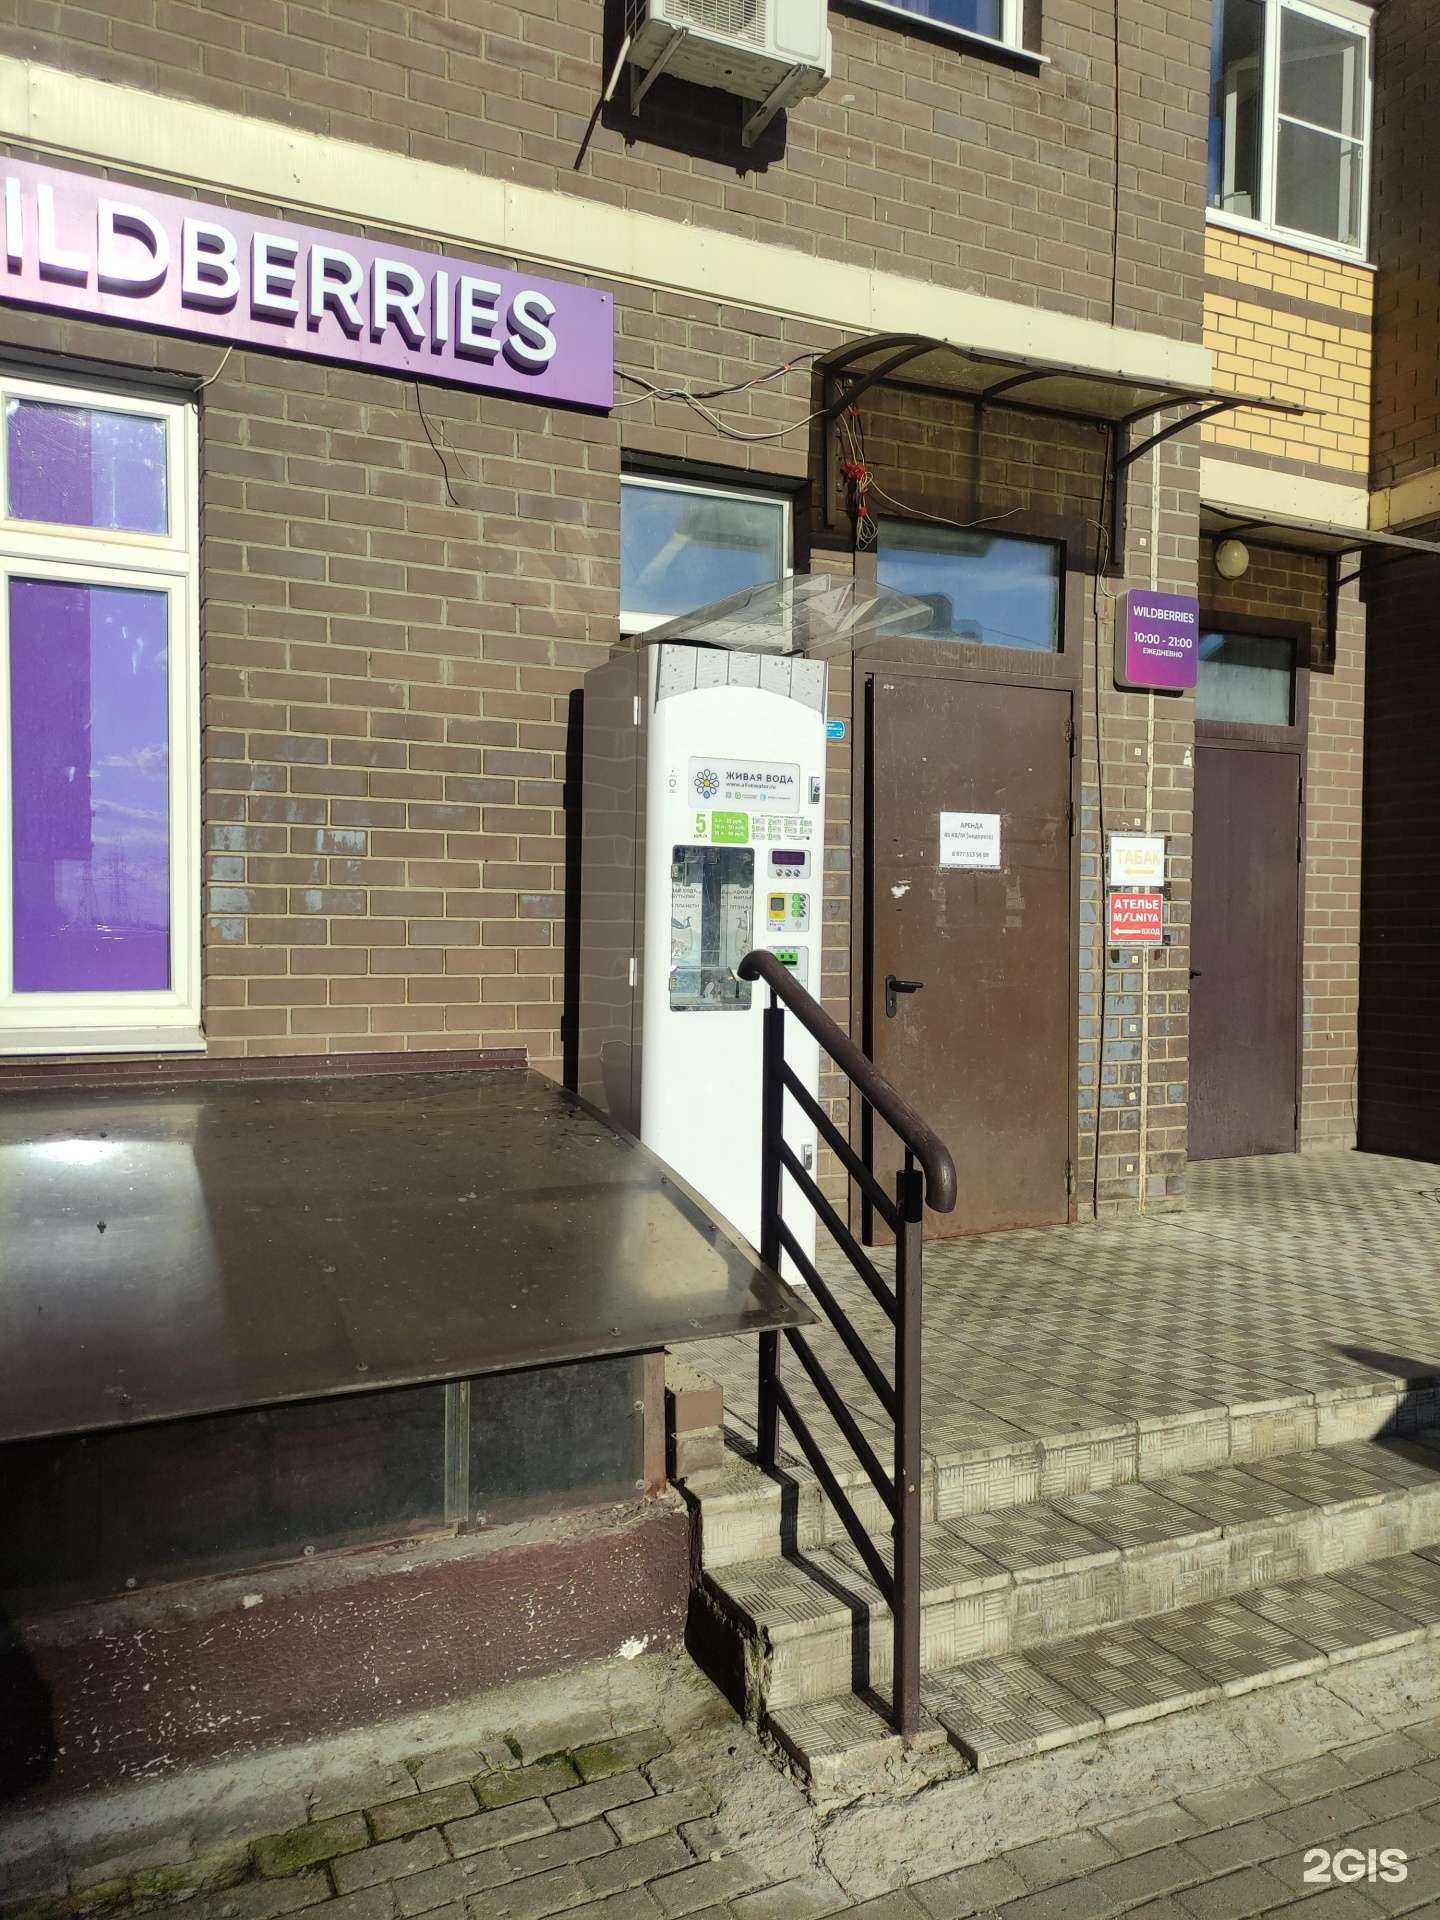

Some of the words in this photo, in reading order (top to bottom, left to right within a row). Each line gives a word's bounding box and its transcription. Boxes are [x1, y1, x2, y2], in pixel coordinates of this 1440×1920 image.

[4, 176, 557, 374] ILDBERRIES
[1133, 605, 1194, 624] WILDBERRIES
[1133, 632, 1160, 645] 10:00
[1168, 636, 1193, 649] 21:00
[1142, 647, 1183, 658] ЕЖЕДНЕВНО
[726, 771, 762, 782] ЖИВАЯ
[766, 774, 794, 784] ВОДА
[695, 813, 706, 833] 5
[960, 822, 983, 830] АРЕНДА
[1115, 848, 1159, 865] ТАБАК
[1114, 898, 1159, 909] АТЕЛЬЕ
[1141, 927, 1160, 937] ВХОД
